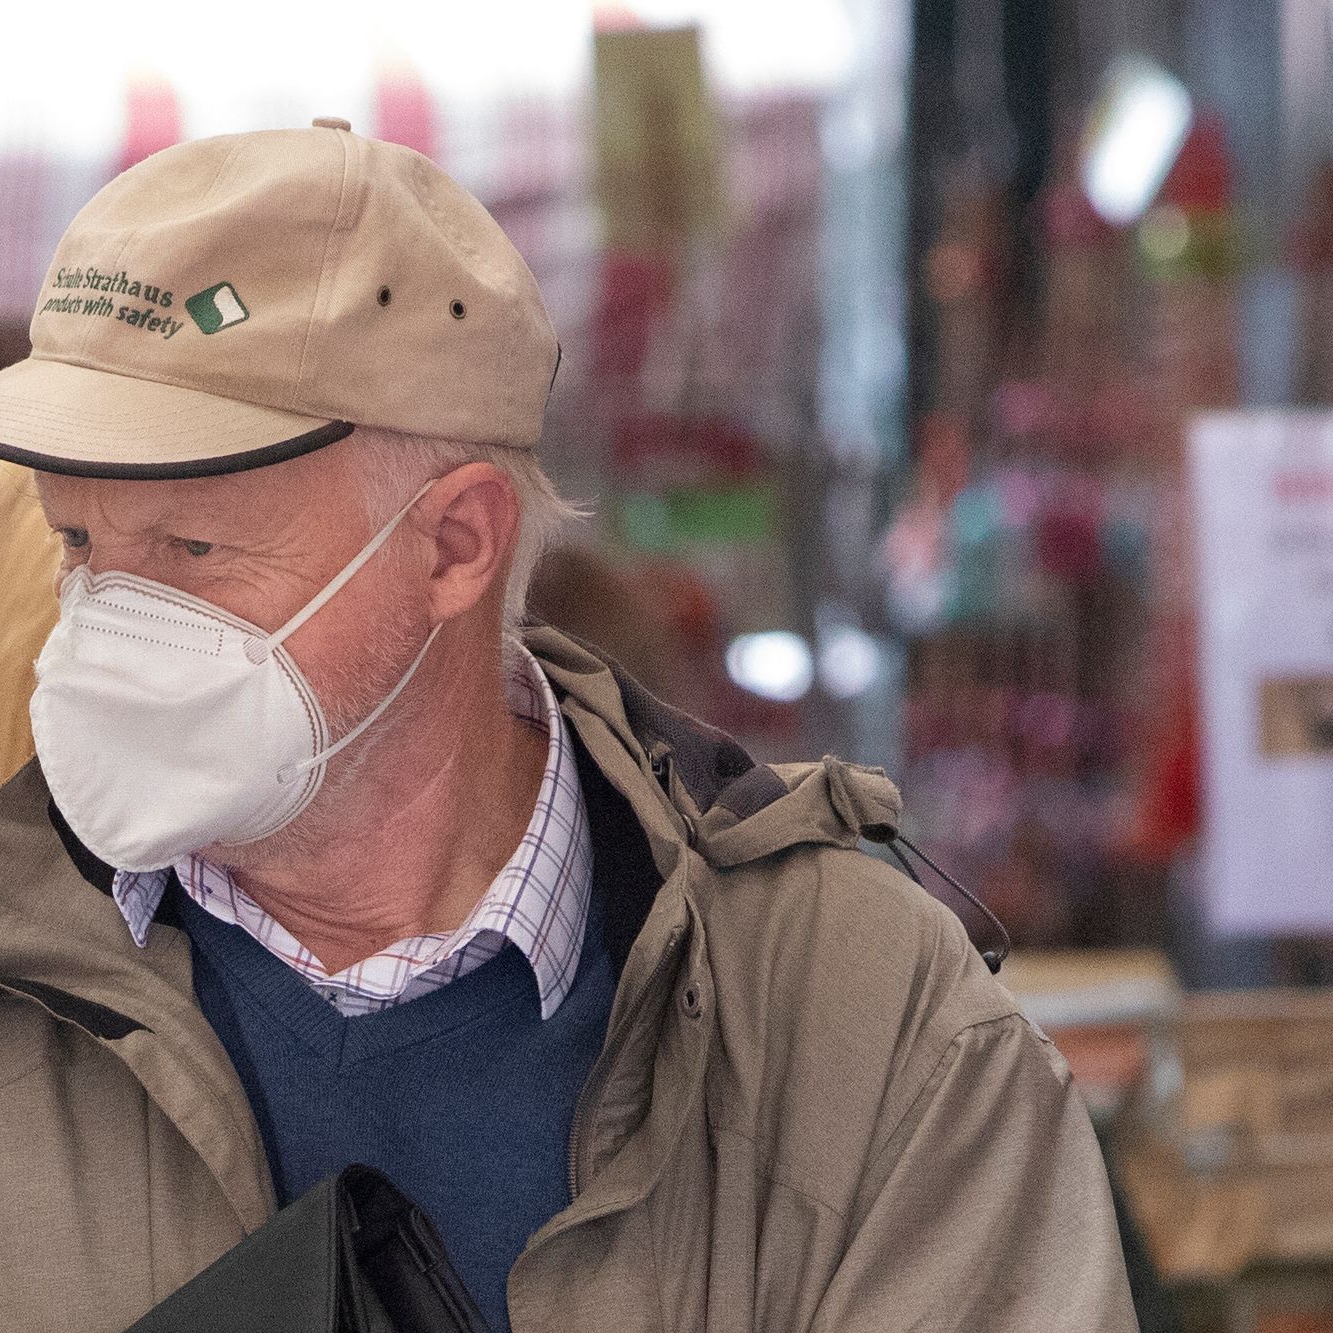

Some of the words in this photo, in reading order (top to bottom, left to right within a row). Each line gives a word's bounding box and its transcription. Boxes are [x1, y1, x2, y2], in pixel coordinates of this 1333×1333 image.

[83, 266, 174, 308] Strathaus
[39, 293, 82, 316] products
[82, 295, 114, 318] with
[115, 305, 184, 340] safety
